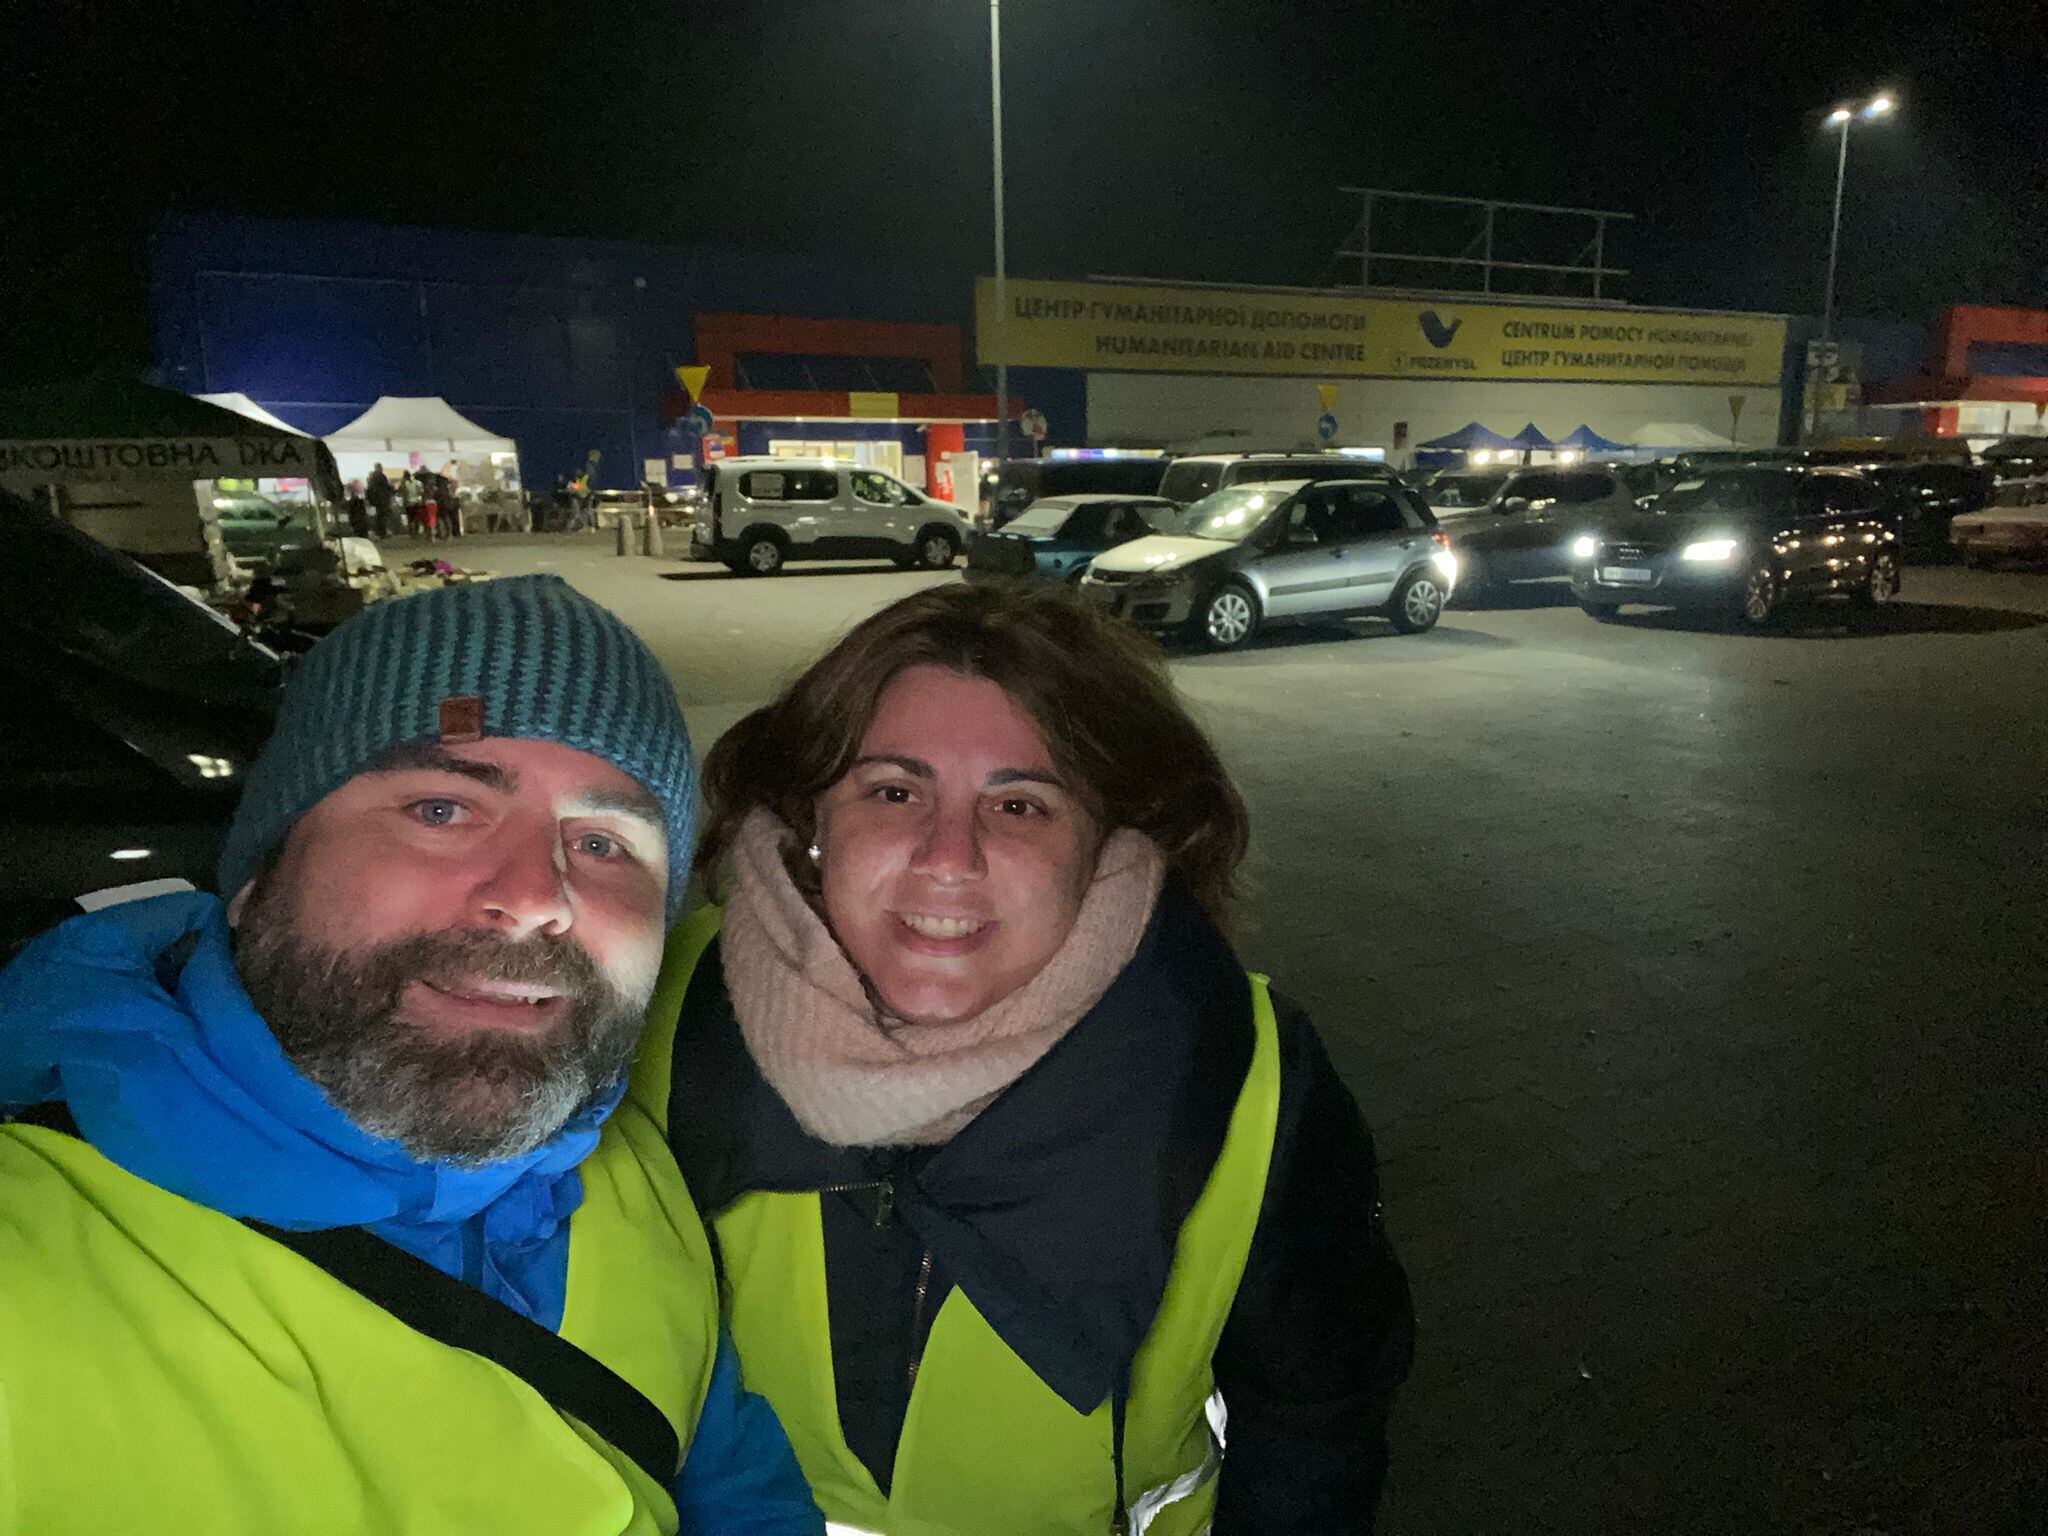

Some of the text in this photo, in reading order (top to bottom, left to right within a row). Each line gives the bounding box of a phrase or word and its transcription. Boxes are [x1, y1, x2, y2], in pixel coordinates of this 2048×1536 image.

[1014, 297, 1085, 320] ЦЕНТР
[1251, 309, 1366, 331] ДОПОМОГИ
[1502, 321, 1575, 339] CENTRUM
[1580, 324, 1645, 342] POMOCY
[1096, 335, 1366, 361] HUMANITARIAN AID CENTRE
[1502, 350, 1550, 367] ЦЕНТР
